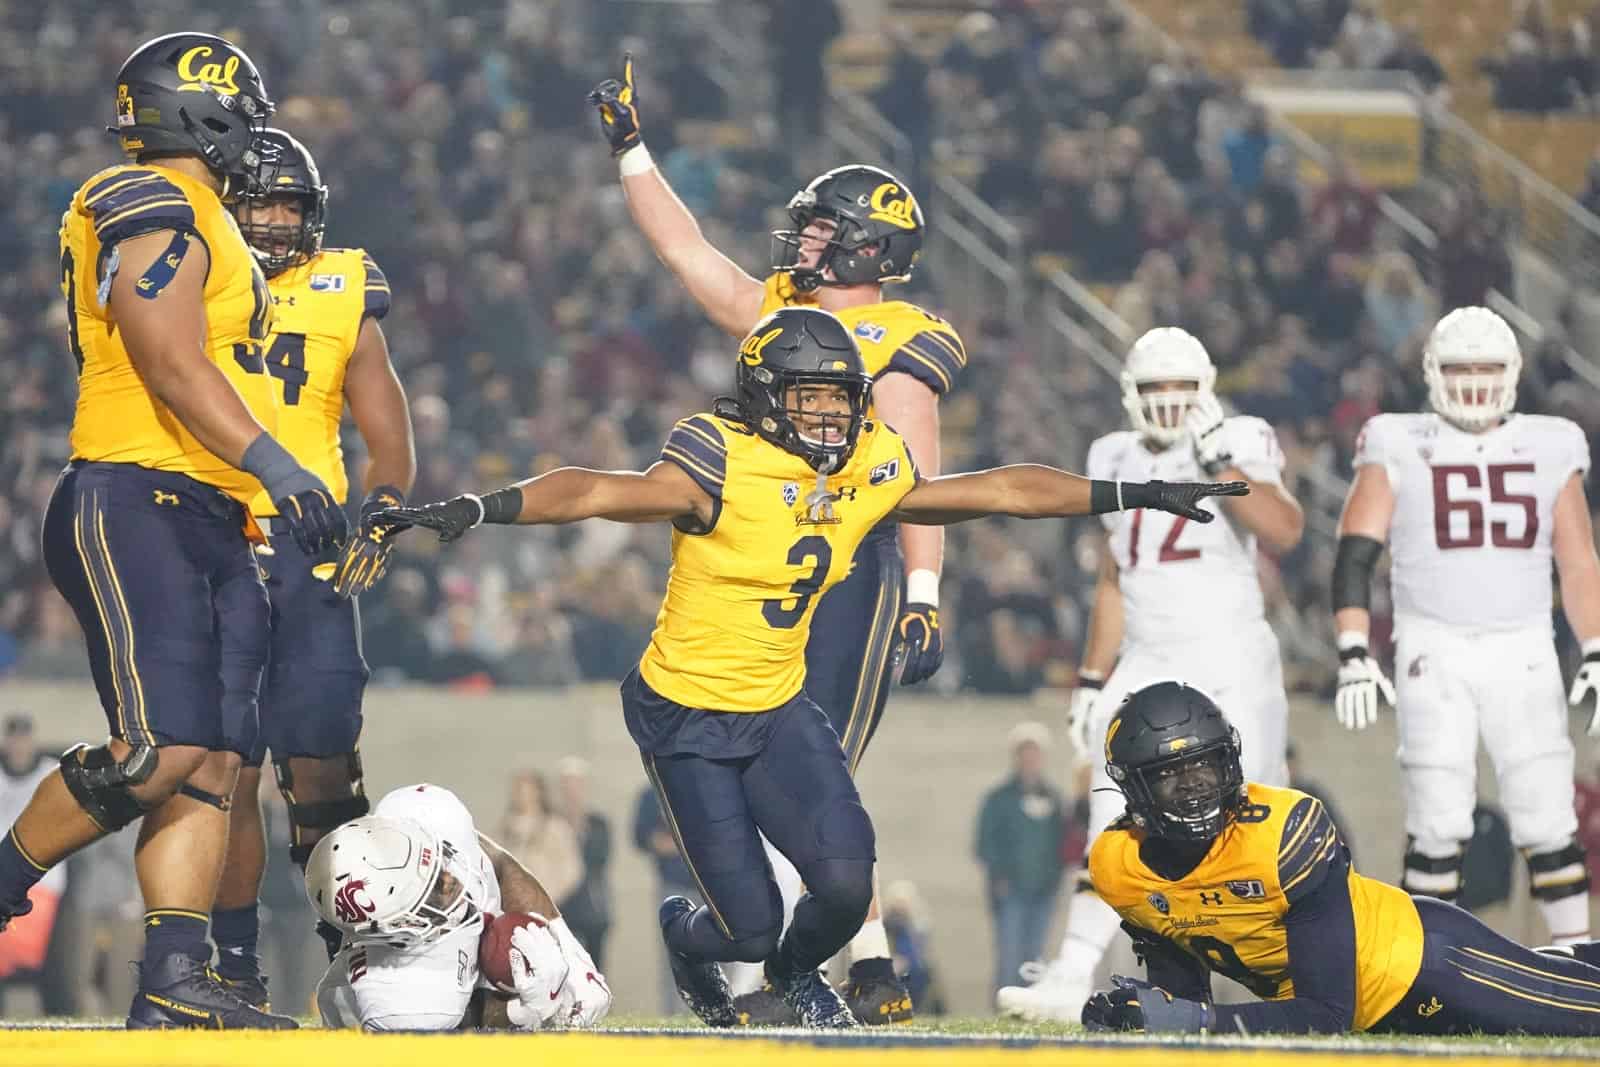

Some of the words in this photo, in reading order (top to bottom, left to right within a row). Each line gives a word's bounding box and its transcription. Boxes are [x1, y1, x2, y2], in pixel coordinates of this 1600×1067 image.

[177, 46, 240, 95] Cal
[868, 183, 916, 229] Cal
[1431, 463, 1540, 550] 65
[761, 535, 833, 628] 3
[1418, 996, 1443, 1016] Cal
